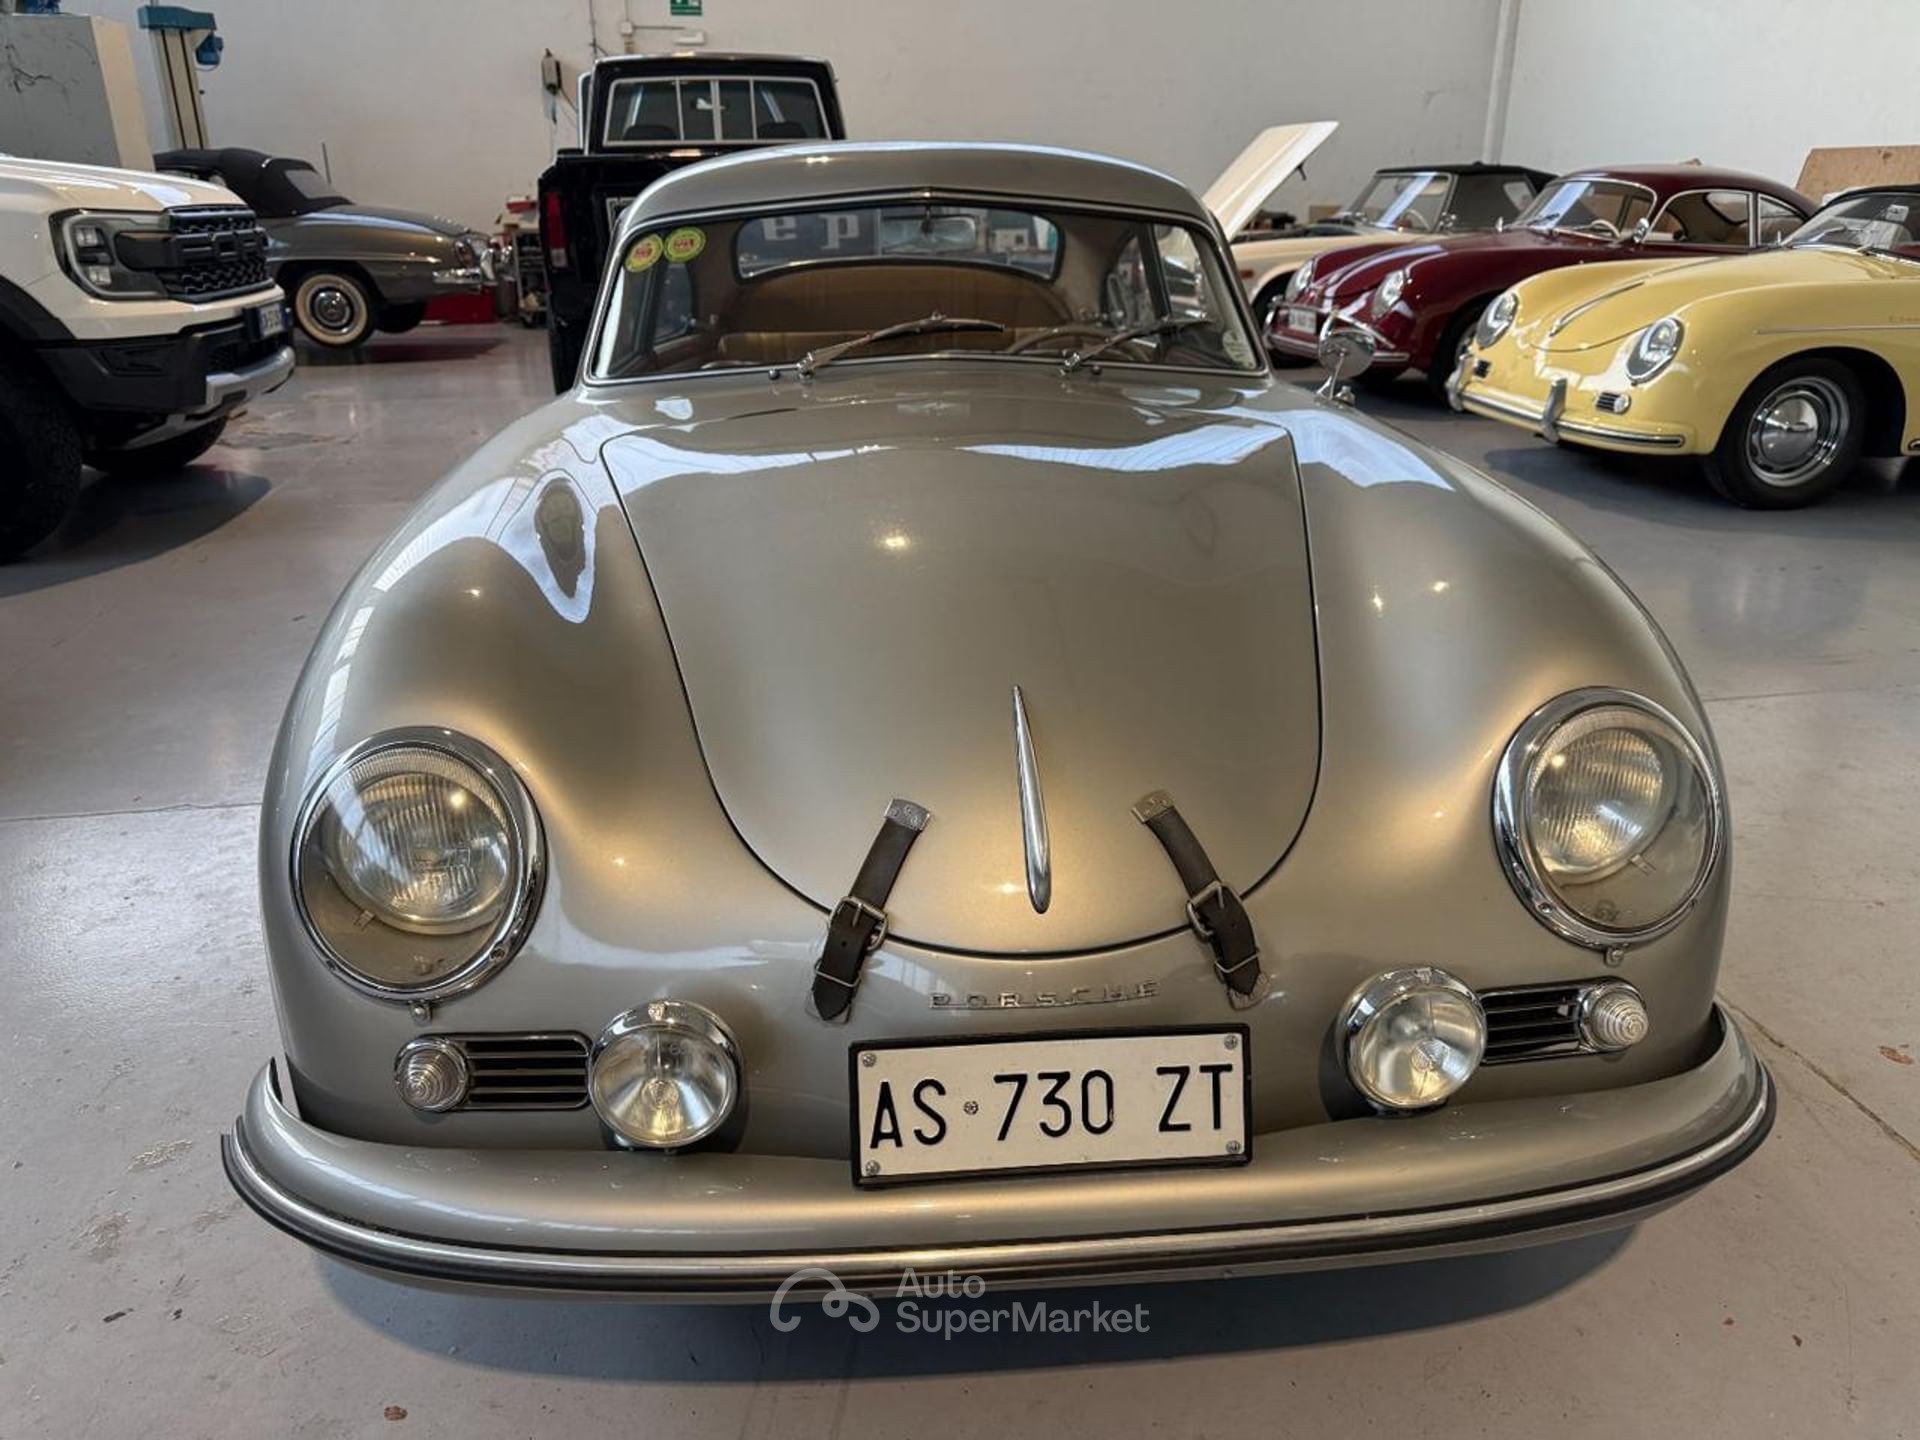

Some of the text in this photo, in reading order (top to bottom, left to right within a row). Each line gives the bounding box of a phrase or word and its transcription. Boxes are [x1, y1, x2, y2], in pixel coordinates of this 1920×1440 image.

[930, 980, 1159, 1009] PORSCHE
[870, 1064, 1233, 1149] AS 730 ZT
